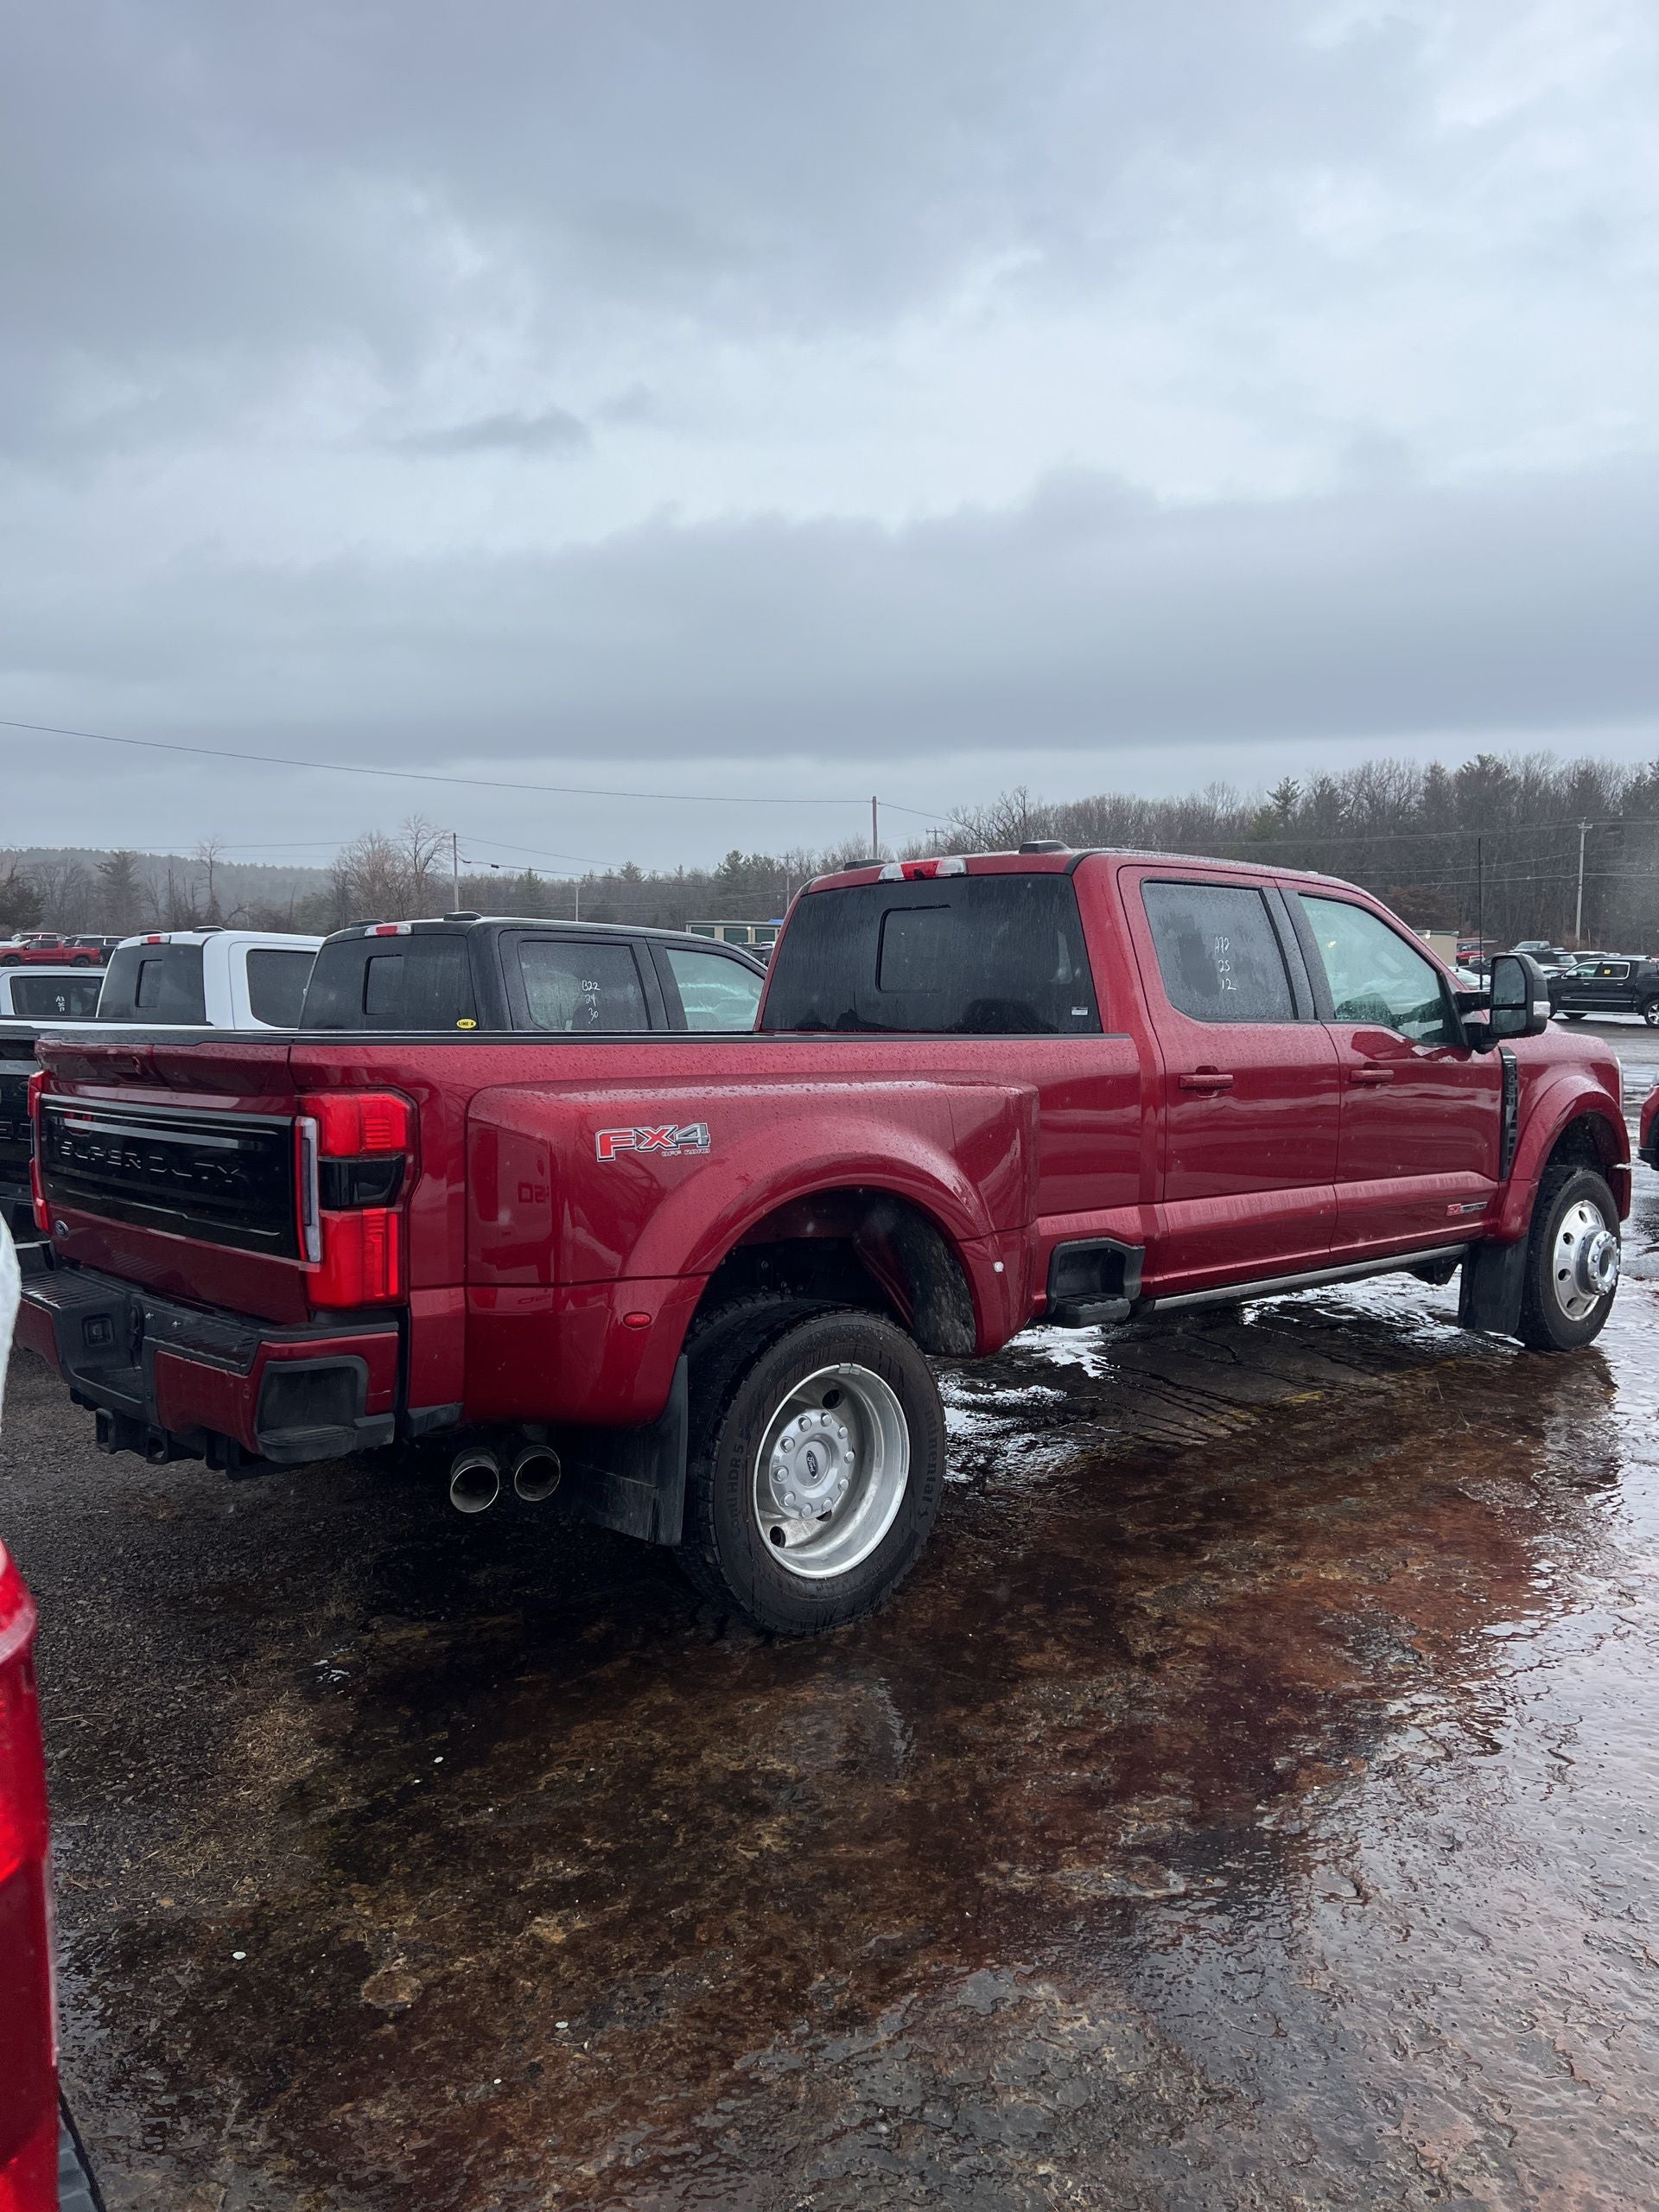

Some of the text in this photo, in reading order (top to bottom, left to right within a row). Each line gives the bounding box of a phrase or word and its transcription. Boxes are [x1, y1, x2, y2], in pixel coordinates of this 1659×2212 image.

[582, 980, 601, 991] B22
[1222, 978, 1237, 990] 12
[595, 1122, 711, 1163] FX4
[60, 1141, 142, 1169] SUPER
